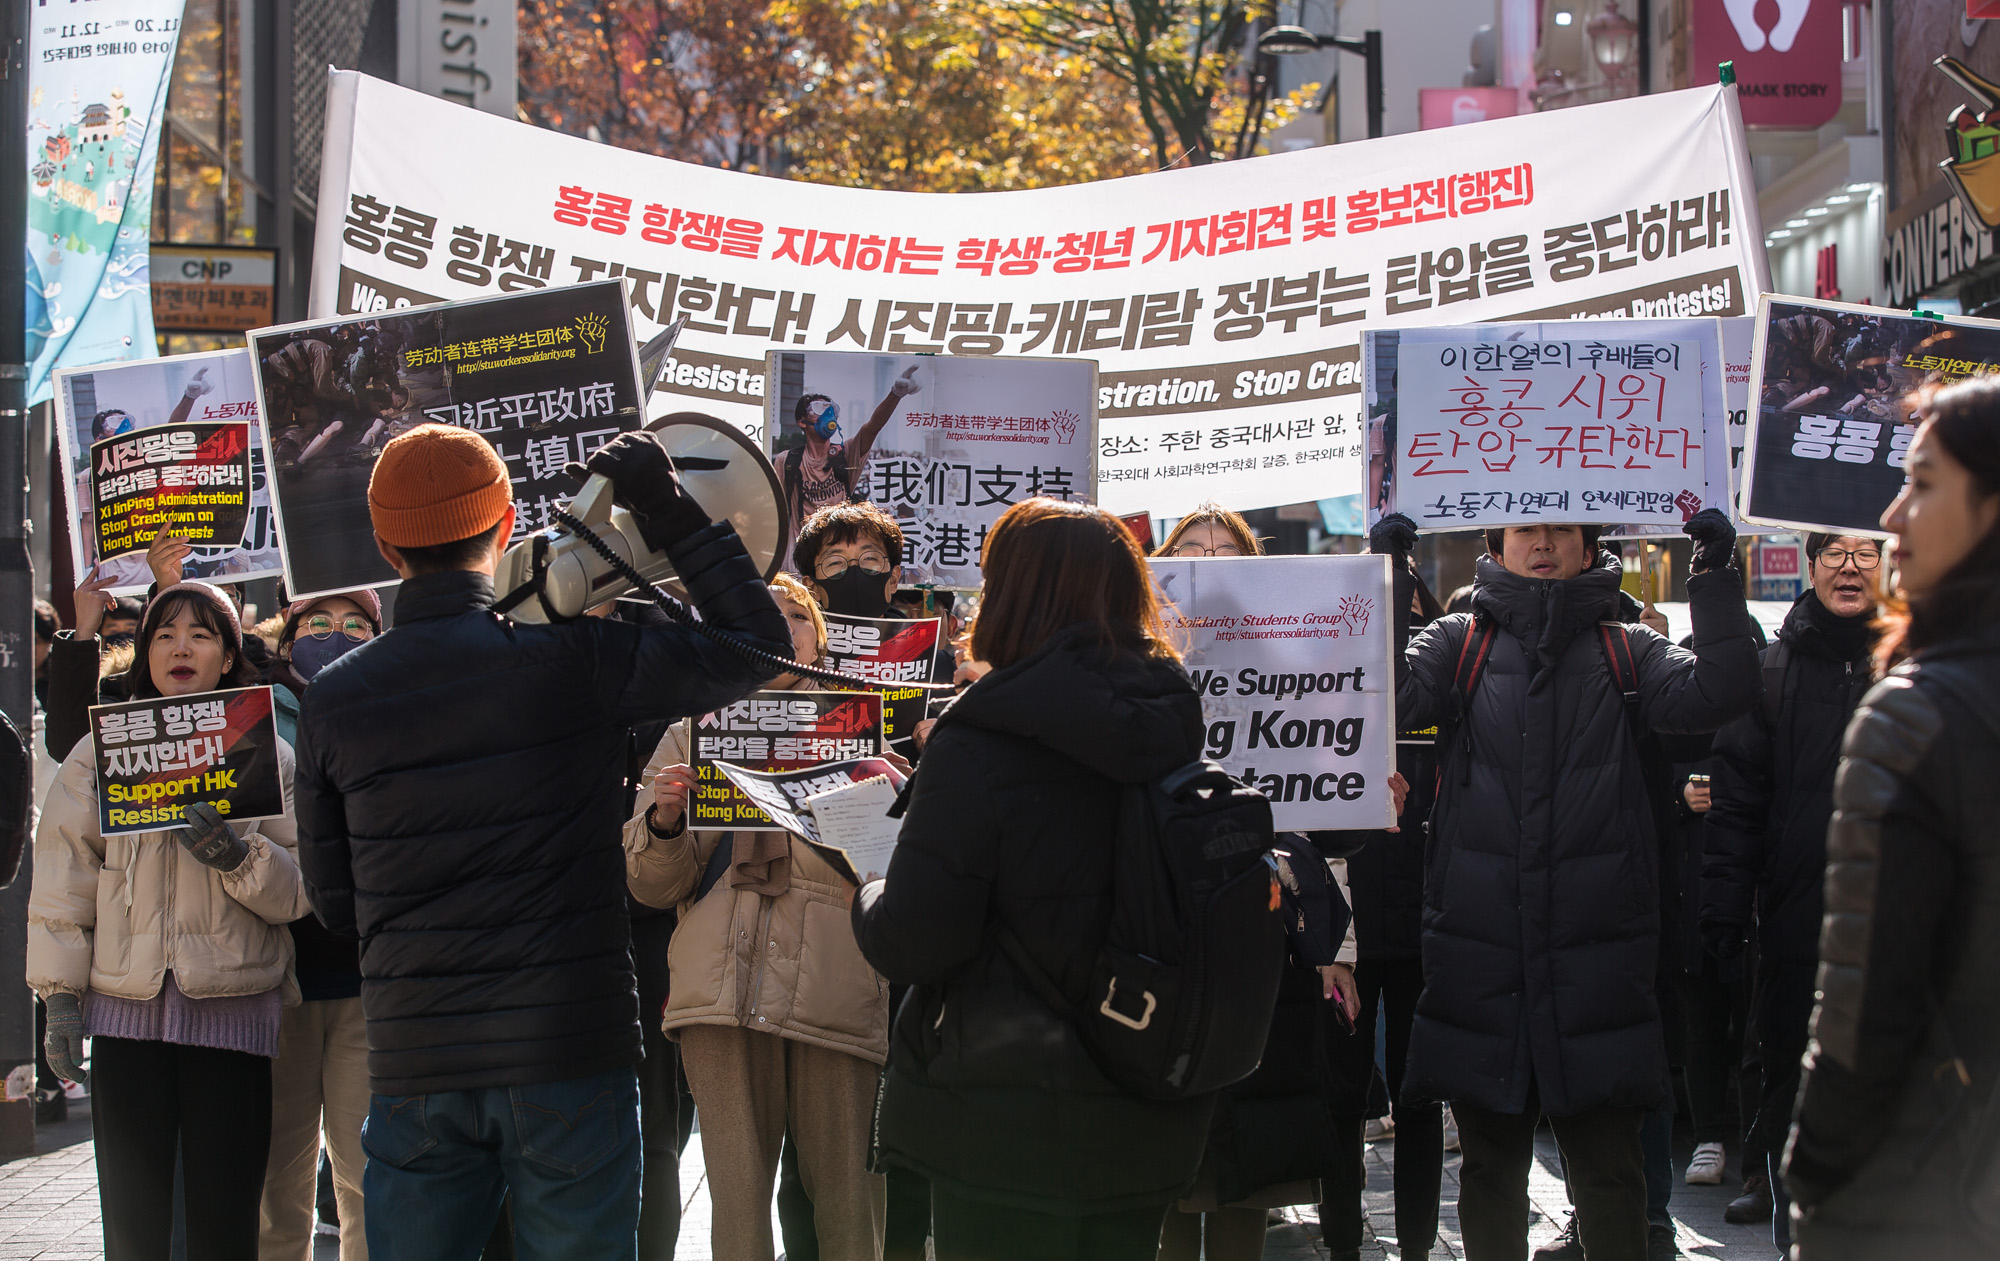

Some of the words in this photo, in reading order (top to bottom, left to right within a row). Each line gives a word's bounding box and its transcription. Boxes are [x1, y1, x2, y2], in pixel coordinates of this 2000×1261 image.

[1784, 84, 1828, 97] STORY
[554, 185, 633, 235] 홍콩
[641, 203, 764, 260] 항쟁을
[770, 226, 944, 276] 지지하는
[955, 226, 1135, 276] 학생·청년
[1142, 203, 1293, 264] 기자회견
[1301, 196, 1336, 242] 및
[1345, 162, 1534, 235] 홍보전(행진)
[182, 261, 232, 279] CNP
[343, 194, 437, 269] 홍콩
[446, 225, 555, 292] 항쟁
[825, 287, 1203, 355] 시진핑·캐리람
[1213, 266, 1371, 342] 정부는
[1385, 234, 1534, 316] 탄압을
[1544, 188, 1731, 282] 중단하라!
[351, 282, 388, 313] We
[1232, 369, 1301, 399] Stop
[405, 325, 574, 368] 劳动者连带学生团体
[1441, 342, 1572, 371] 이한열의
[1577, 341, 1680, 371] 후배들이
[1439, 375, 1546, 428] 홍콩
[1558, 372, 1666, 423] 시위
[906, 413, 1051, 432] 劳动者连带学生团体
[1100, 435, 1148, 457] 장소:
[1159, 430, 1202, 453] 주한
[1209, 418, 1315, 449] 중국대사관
[1323, 414, 1346, 435] 앞,
[1791, 414, 1881, 464] 홍콩
[97, 431, 198, 477] 시진핑은
[1098, 468, 1149, 482] 한국외대
[1154, 457, 1257, 479] 사회과학연구학회
[1262, 453, 1289, 469] 갈증,
[1295, 446, 1344, 464] 한국외대
[1408, 429, 1532, 477] 탄압
[1536, 423, 1702, 470] 규탄한다
[99, 467, 158, 501] 탄압을
[162, 464, 243, 487] 중단하라!
[873, 460, 1073, 507] 我们支持
[100, 505, 112, 520] Xi
[113, 495, 155, 516] JinPing
[158, 491, 243, 506] Administration!
[1423, 490, 1569, 519] 노동자연대
[1581, 489, 1675, 515] 연세대모임
[101, 519, 128, 536] Stop
[130, 510, 195, 528] Crackdown
[198, 511, 214, 522] on
[103, 535, 132, 552] Hong
[166, 525, 214, 539] rotests
[1176, 614, 1239, 629] Solidarity
[1241, 613, 1299, 627] Students
[1303, 612, 1342, 627] Group
[1236, 667, 1365, 701] Support
[99, 709, 157, 744] 홍콩
[162, 700, 227, 736] 항쟁
[698, 700, 818, 732] 시진핑은
[1247, 709, 1365, 756] Kong
[104, 735, 226, 778] 지지한다!
[698, 737, 769, 760] 탄압을
[774, 737, 874, 760] 중단하라!
[108, 776, 200, 804] Support
[204, 769, 237, 791] HK
[697, 766, 711, 780] Xi
[1230, 768, 1365, 802] tance
[697, 785, 730, 802] Stop
[696, 804, 732, 822] Hong
[736, 804, 772, 822] Kong
